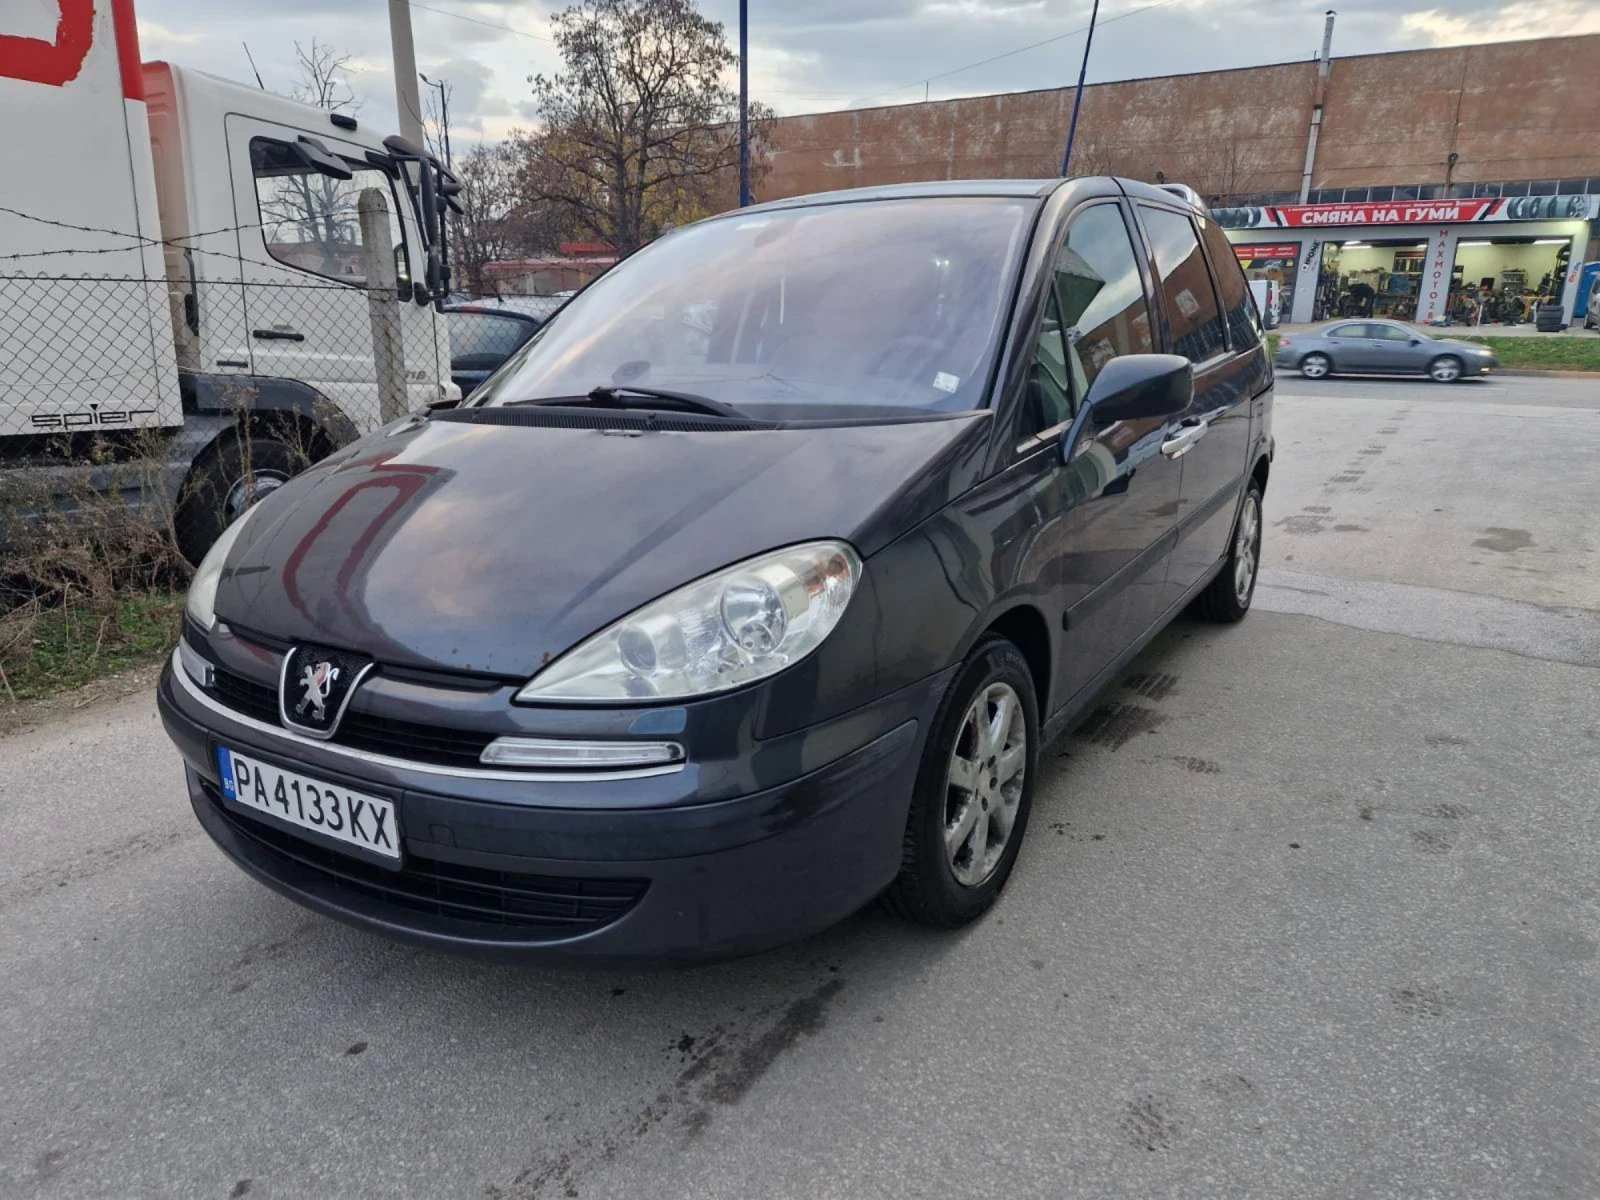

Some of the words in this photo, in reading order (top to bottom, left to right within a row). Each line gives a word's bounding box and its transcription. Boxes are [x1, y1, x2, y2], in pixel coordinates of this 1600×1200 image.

[1301, 210, 1367, 225] СМЯНА
[1372, 208, 1399, 222] НА
[1405, 206, 1460, 221] ГУМИ
[31, 404, 156, 431] spier
[223, 777, 235, 791] BG
[233, 757, 392, 849] PA4133KX
